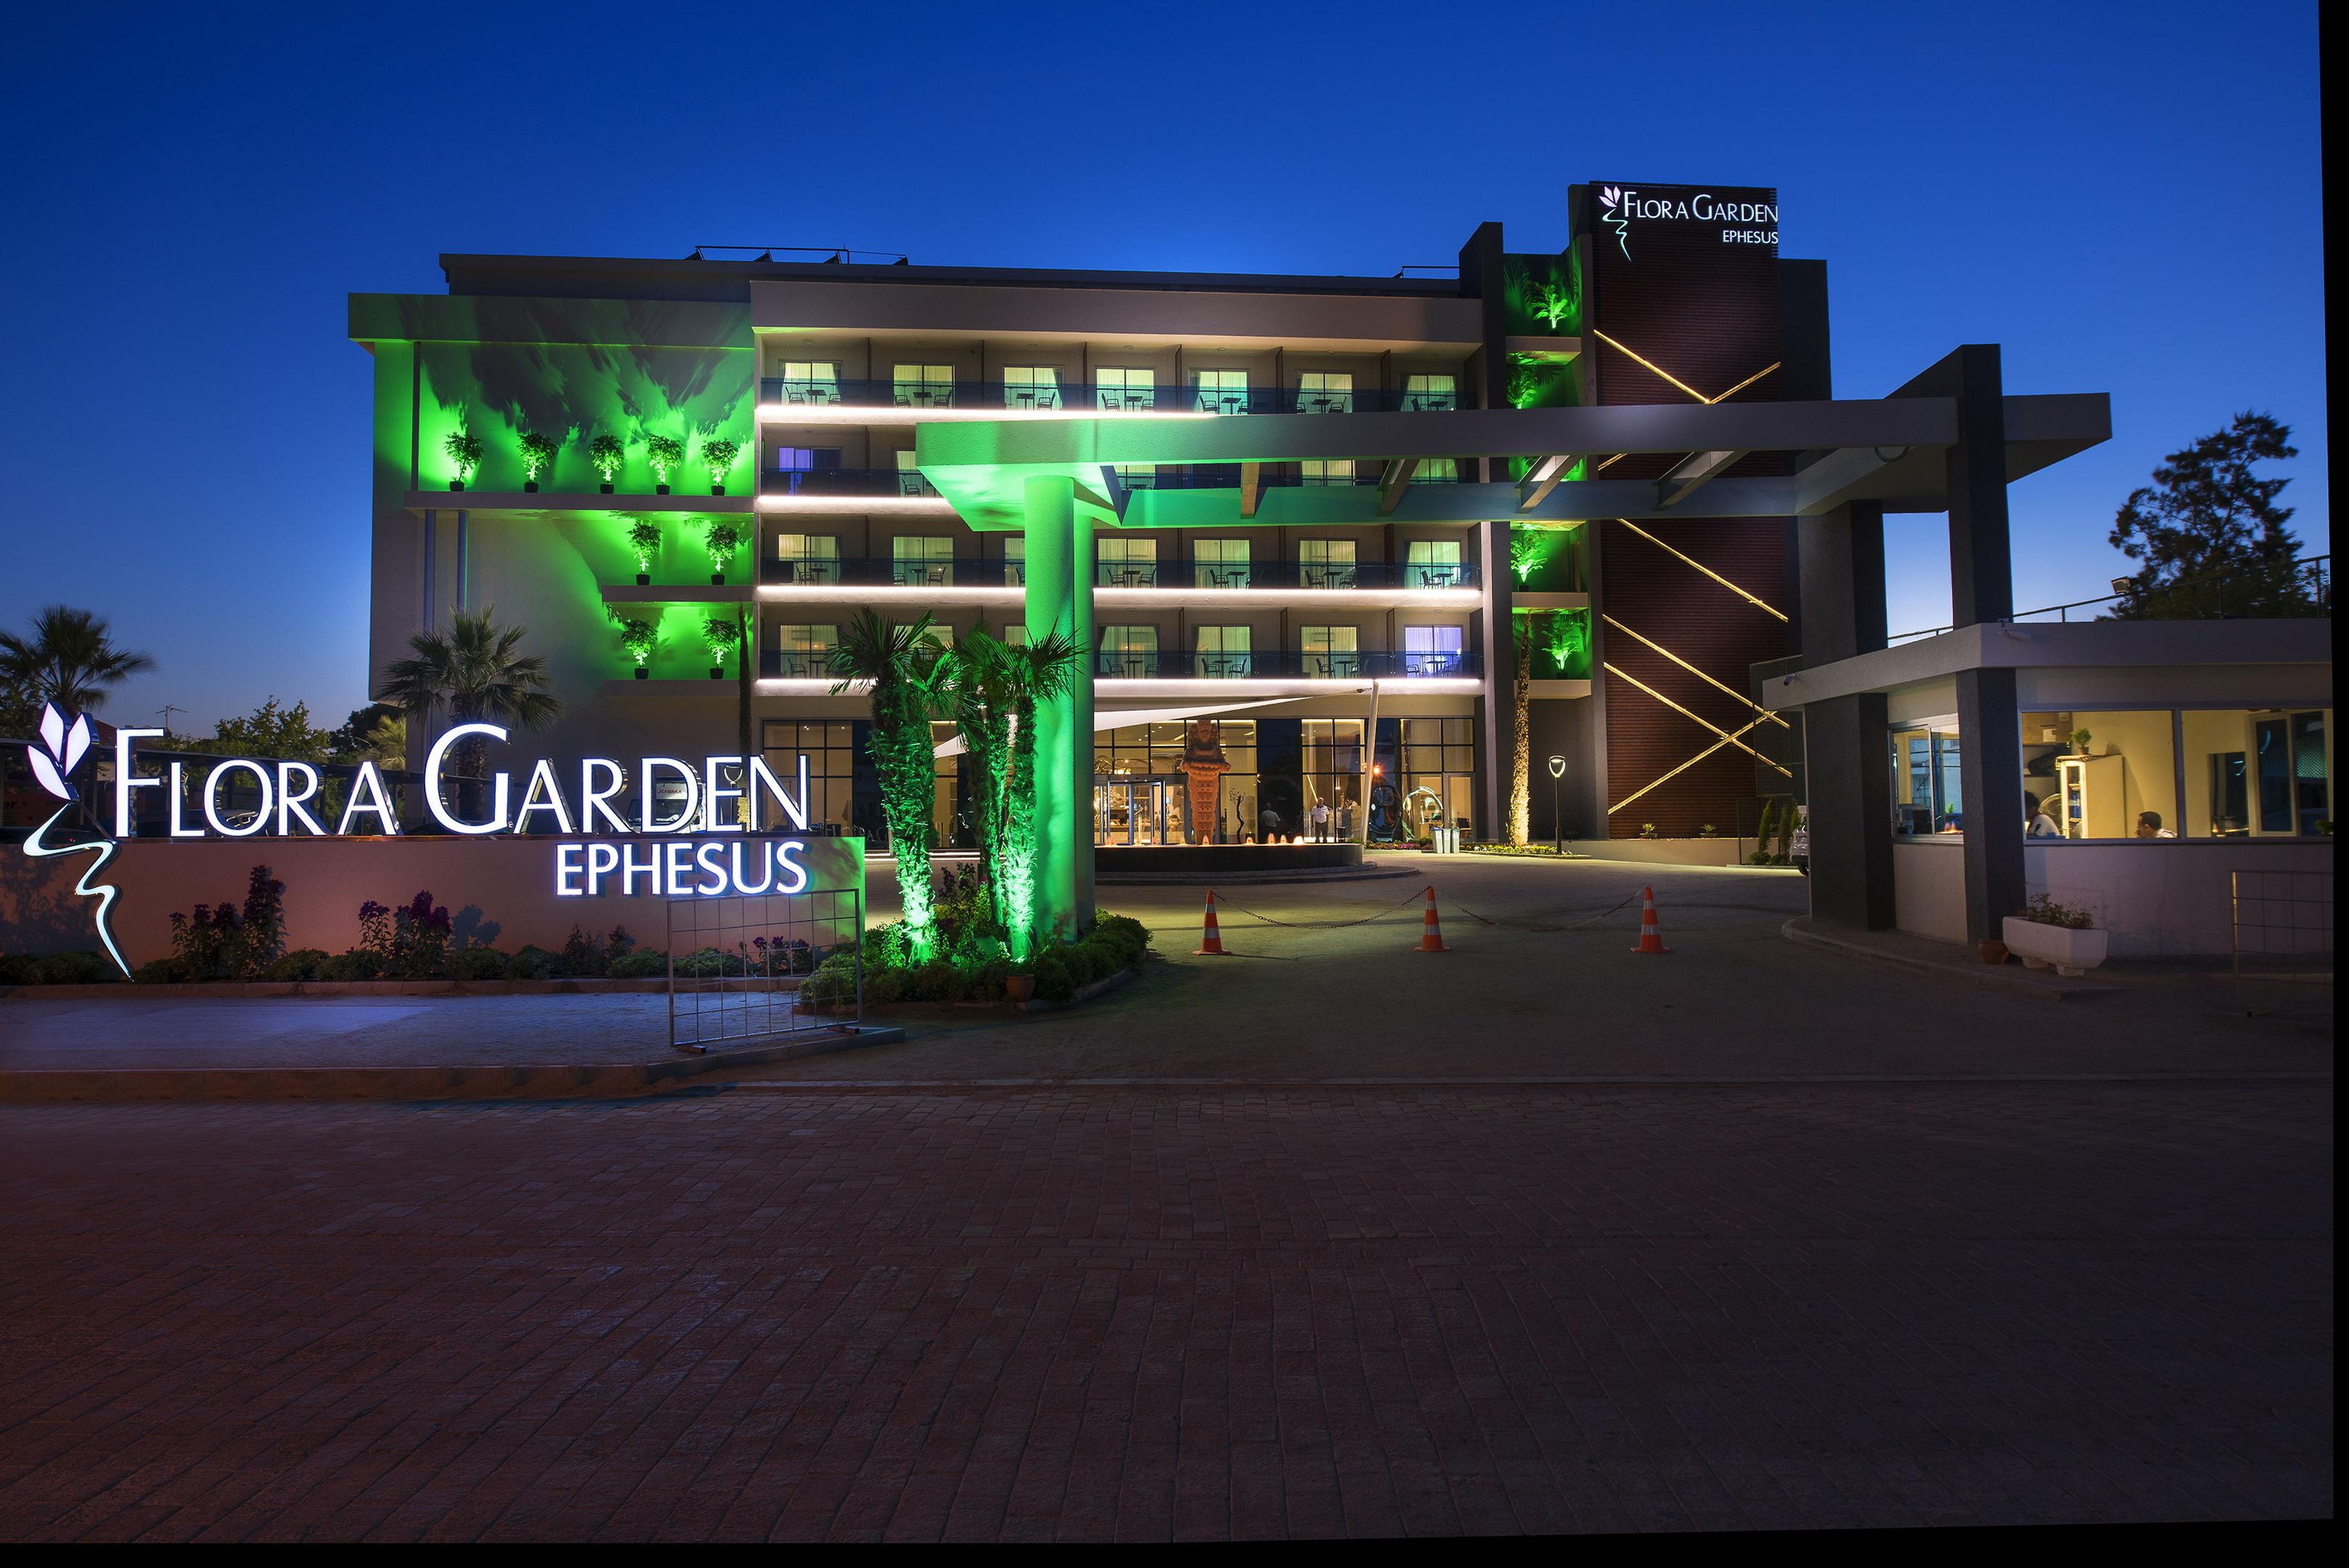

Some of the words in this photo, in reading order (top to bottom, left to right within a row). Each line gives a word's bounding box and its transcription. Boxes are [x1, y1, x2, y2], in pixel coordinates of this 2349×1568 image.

[1623, 192, 1689, 220] FLORA
[1692, 195, 1778, 222] GARDEN
[1723, 230, 1779, 244] EPHESUS
[115, 727, 400, 838] FLORA
[425, 723, 810, 835] GARDEN
[556, 841, 807, 896] EPHESUS
